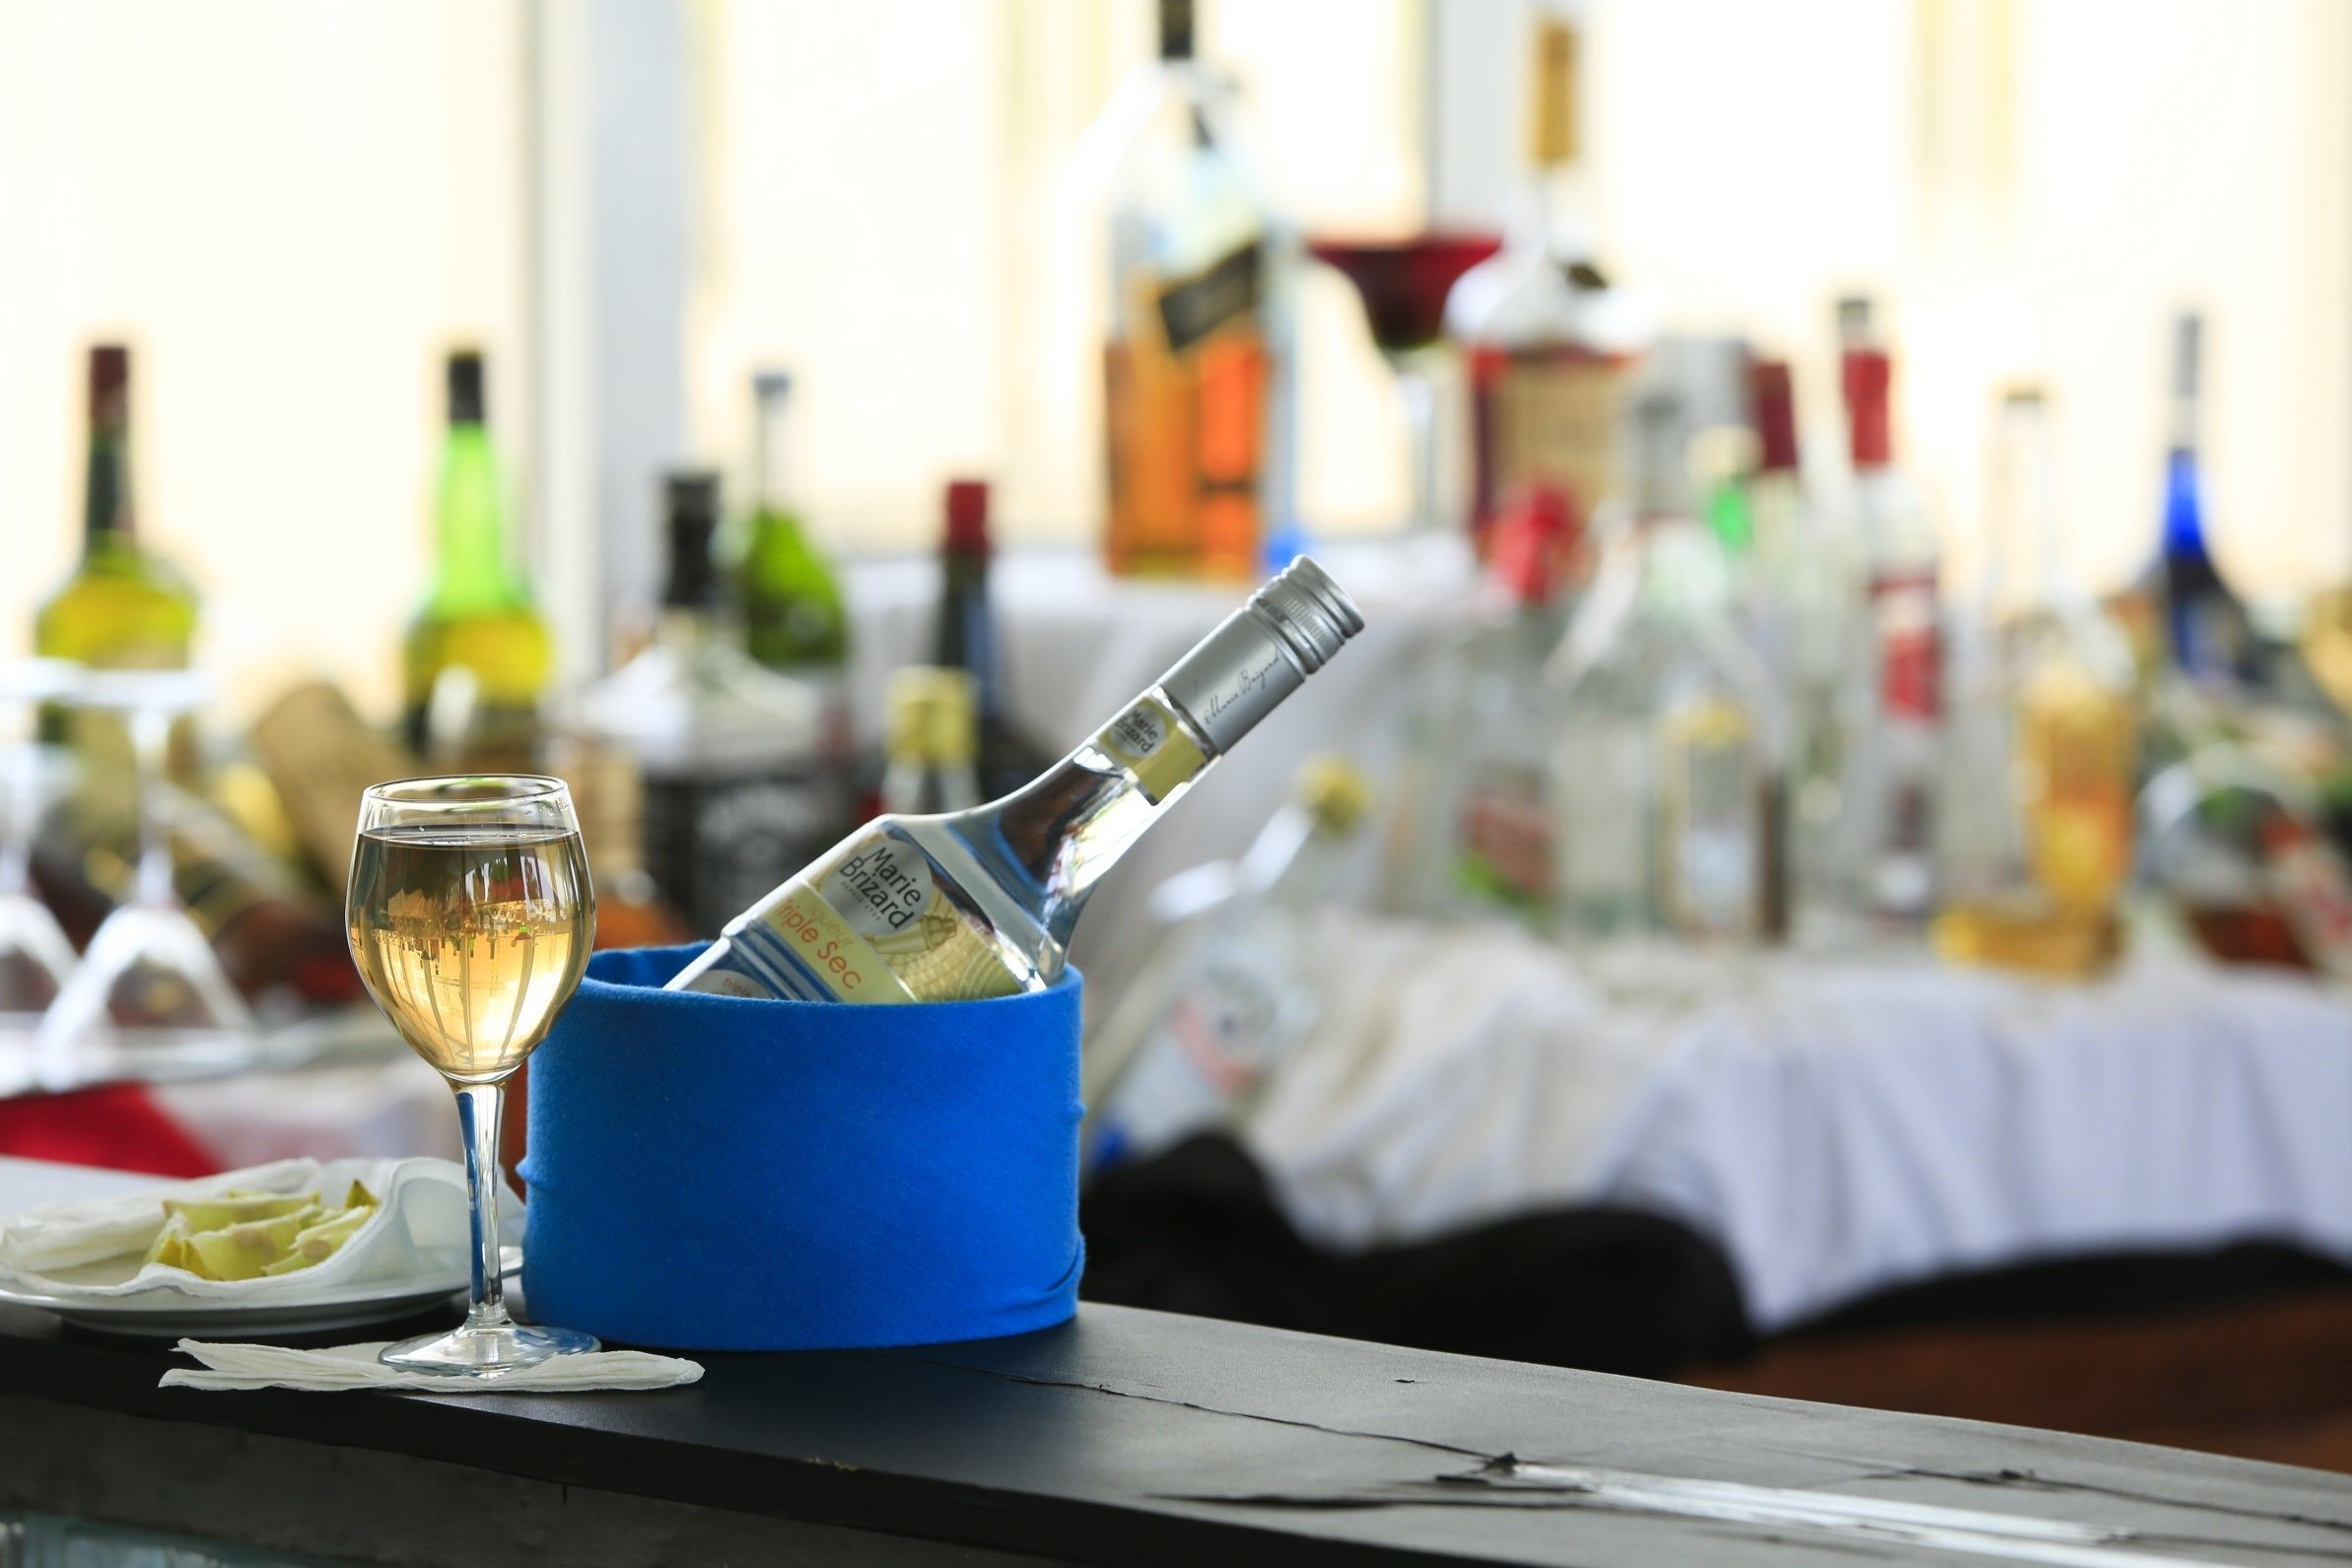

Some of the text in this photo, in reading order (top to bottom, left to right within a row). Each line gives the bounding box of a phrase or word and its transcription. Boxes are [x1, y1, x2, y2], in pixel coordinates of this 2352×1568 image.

[840, 856, 916, 930] Brizard
[864, 847, 922, 907] Marie
[817, 940, 862, 989] Sec
